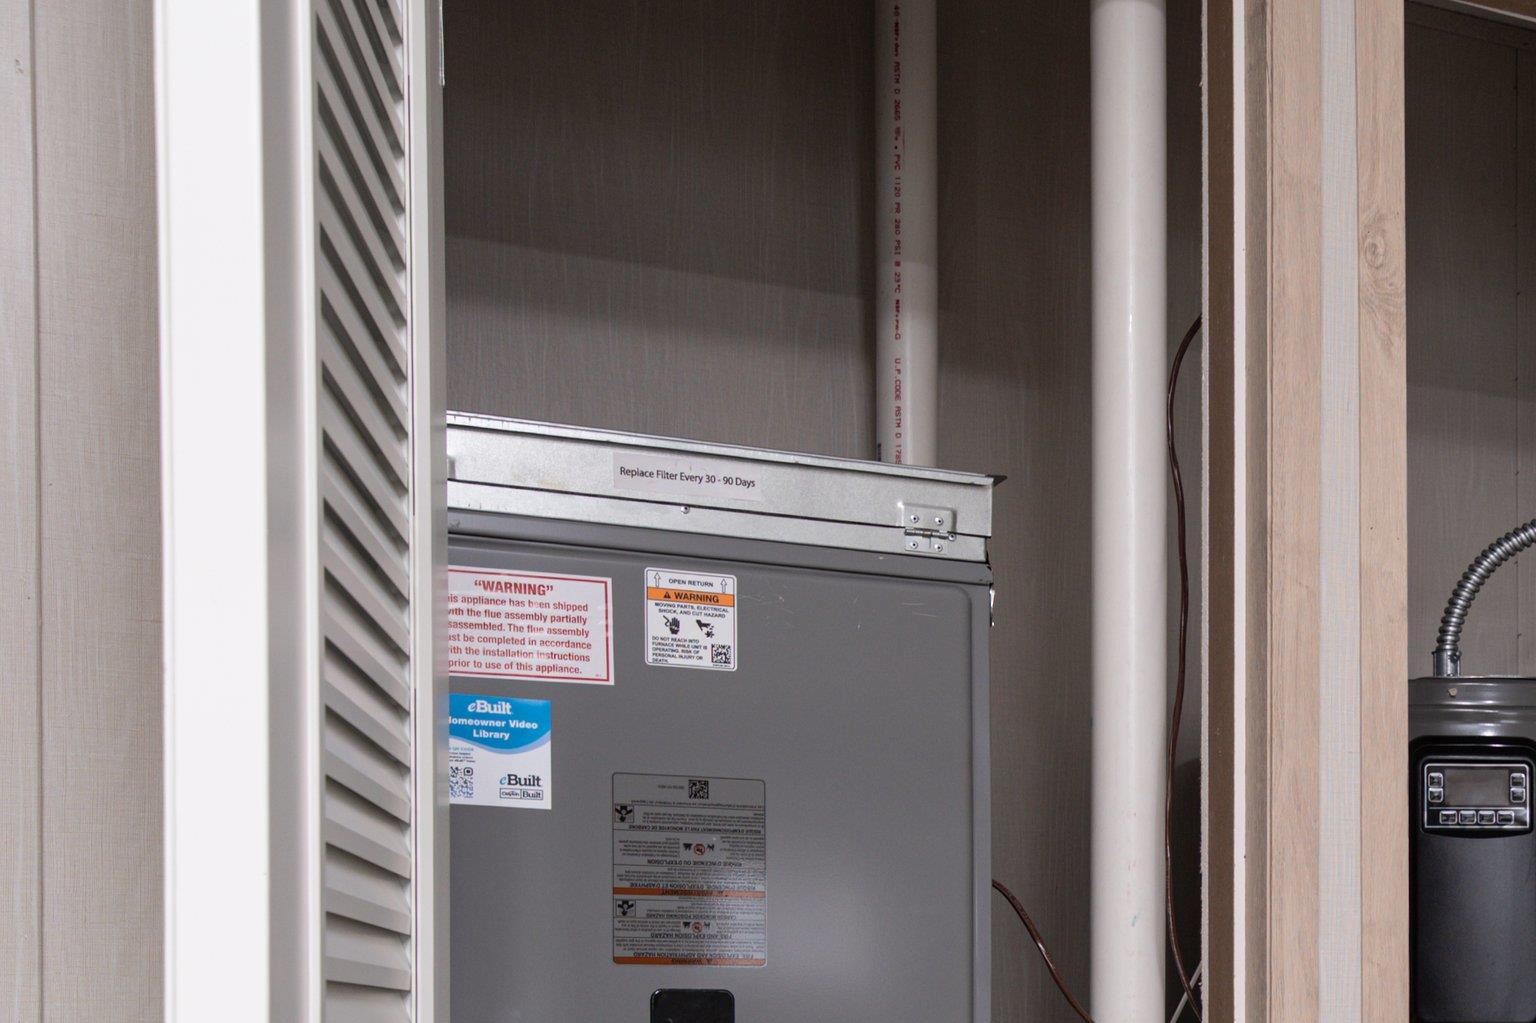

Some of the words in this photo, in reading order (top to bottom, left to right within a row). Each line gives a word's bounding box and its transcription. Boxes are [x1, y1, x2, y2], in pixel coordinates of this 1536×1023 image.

[893, 62, 901, 84] ASTM
[893, 154, 901, 170] PVC
[893, 177, 901, 198] 1120
[893, 202, 901, 215] PR
[893, 240, 901, 256] PSI
[894, 406, 902, 428] ASTM
[620, 466, 654, 478] Replace
[656, 470, 678, 480] Filter
[680, 472, 703, 484] Every
[706, 475, 716, 484] 30
[722, 476, 734, 486] 90
[735, 478, 756, 488] Days
[462, 596, 506, 608] appliance
[508, 599, 525, 607] has
[527, 600, 550, 609] been
[552, 601, 588, 613] shipped
[674, 592, 719, 602] WARNING
[466, 609, 481, 617] the
[483, 610, 501, 618] flue
[504, 611, 547, 623] assembly
[550, 613, 587, 625] partially
[508, 625, 524, 633] The
[526, 625, 544, 634] flue
[546, 627, 589, 638] assembly
[462, 634, 474, 642] be
[477, 634, 525, 647] completed
[528, 637, 537, 646] in
[539, 638, 592, 649] accordance
[464, 647, 480, 655] the
[482, 648, 534, 658] installation
[536, 651, 590, 661] instructions
[473, 660, 482, 668] to
[504, 662, 513, 670] of
[515, 663, 533, 671] this
[535, 664, 582, 676] appliance.
[468, 700, 512, 714] eBuilt
[509, 719, 538, 730] Video
[473, 729, 510, 740] Library
[500, 774, 542, 786] eBuilt
[522, 790, 542, 798] Built
